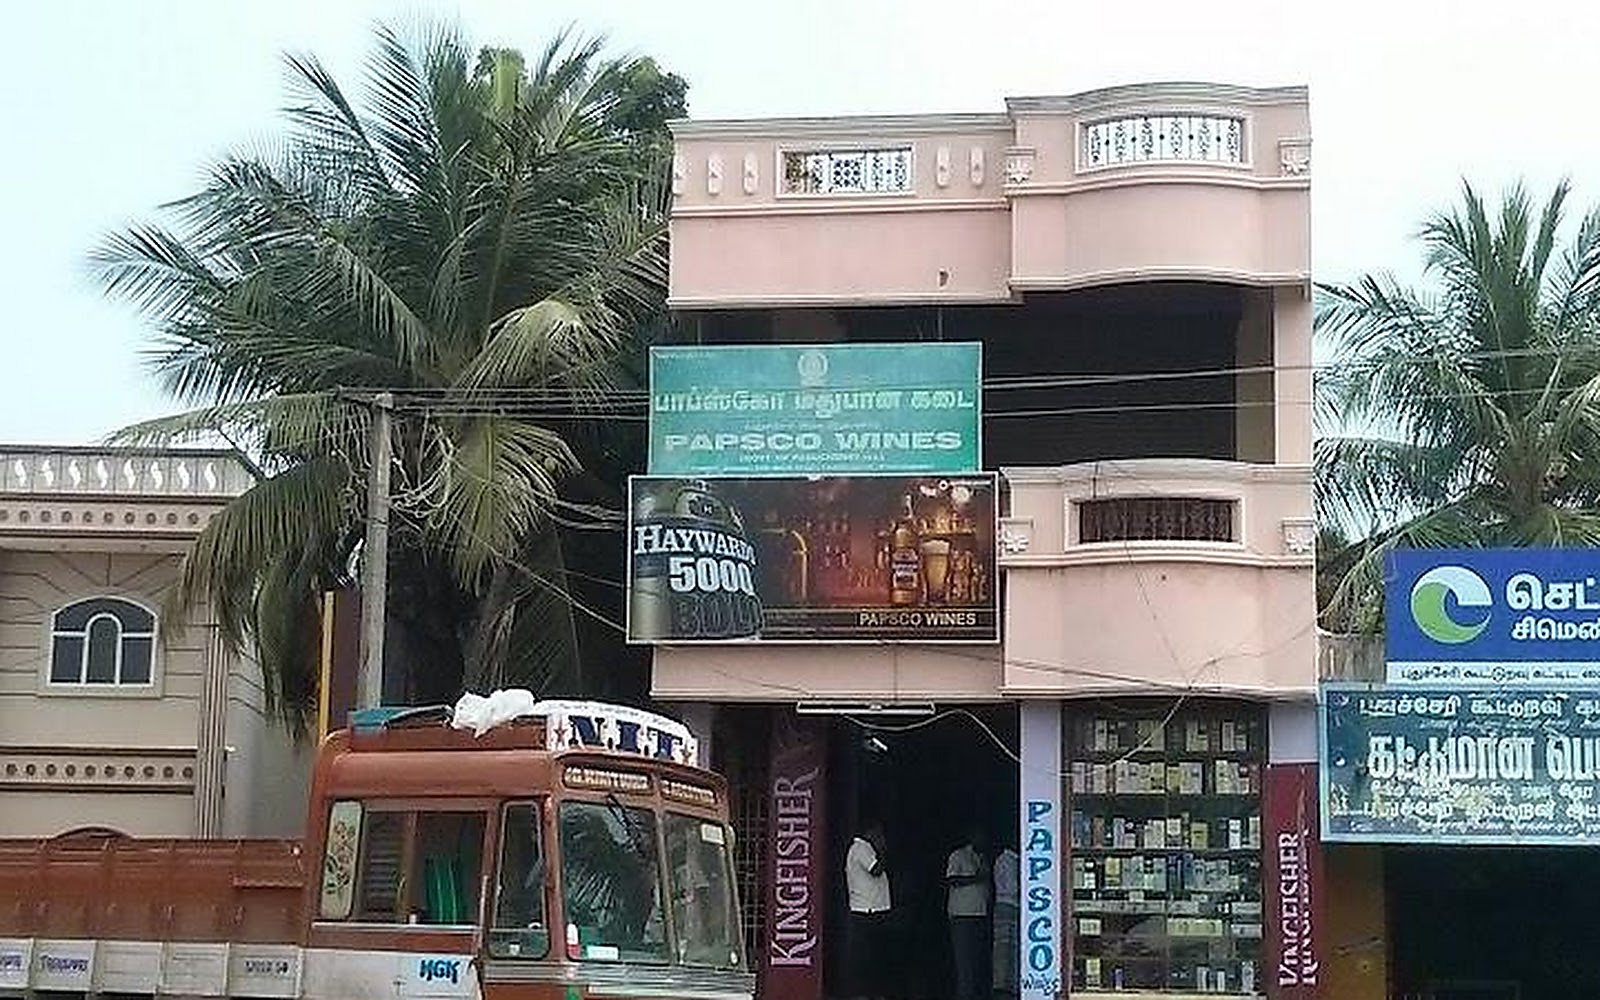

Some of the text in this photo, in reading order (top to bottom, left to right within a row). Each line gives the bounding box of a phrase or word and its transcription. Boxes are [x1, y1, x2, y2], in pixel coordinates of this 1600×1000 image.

[664, 432, 962, 451] PAPSCO WINES
[669, 556, 756, 596] 5000
[859, 612, 977, 627] PAPSCO WINES
[771, 767, 820, 966] KINGFISHER
[1027, 801, 1054, 972] PAPSCO
